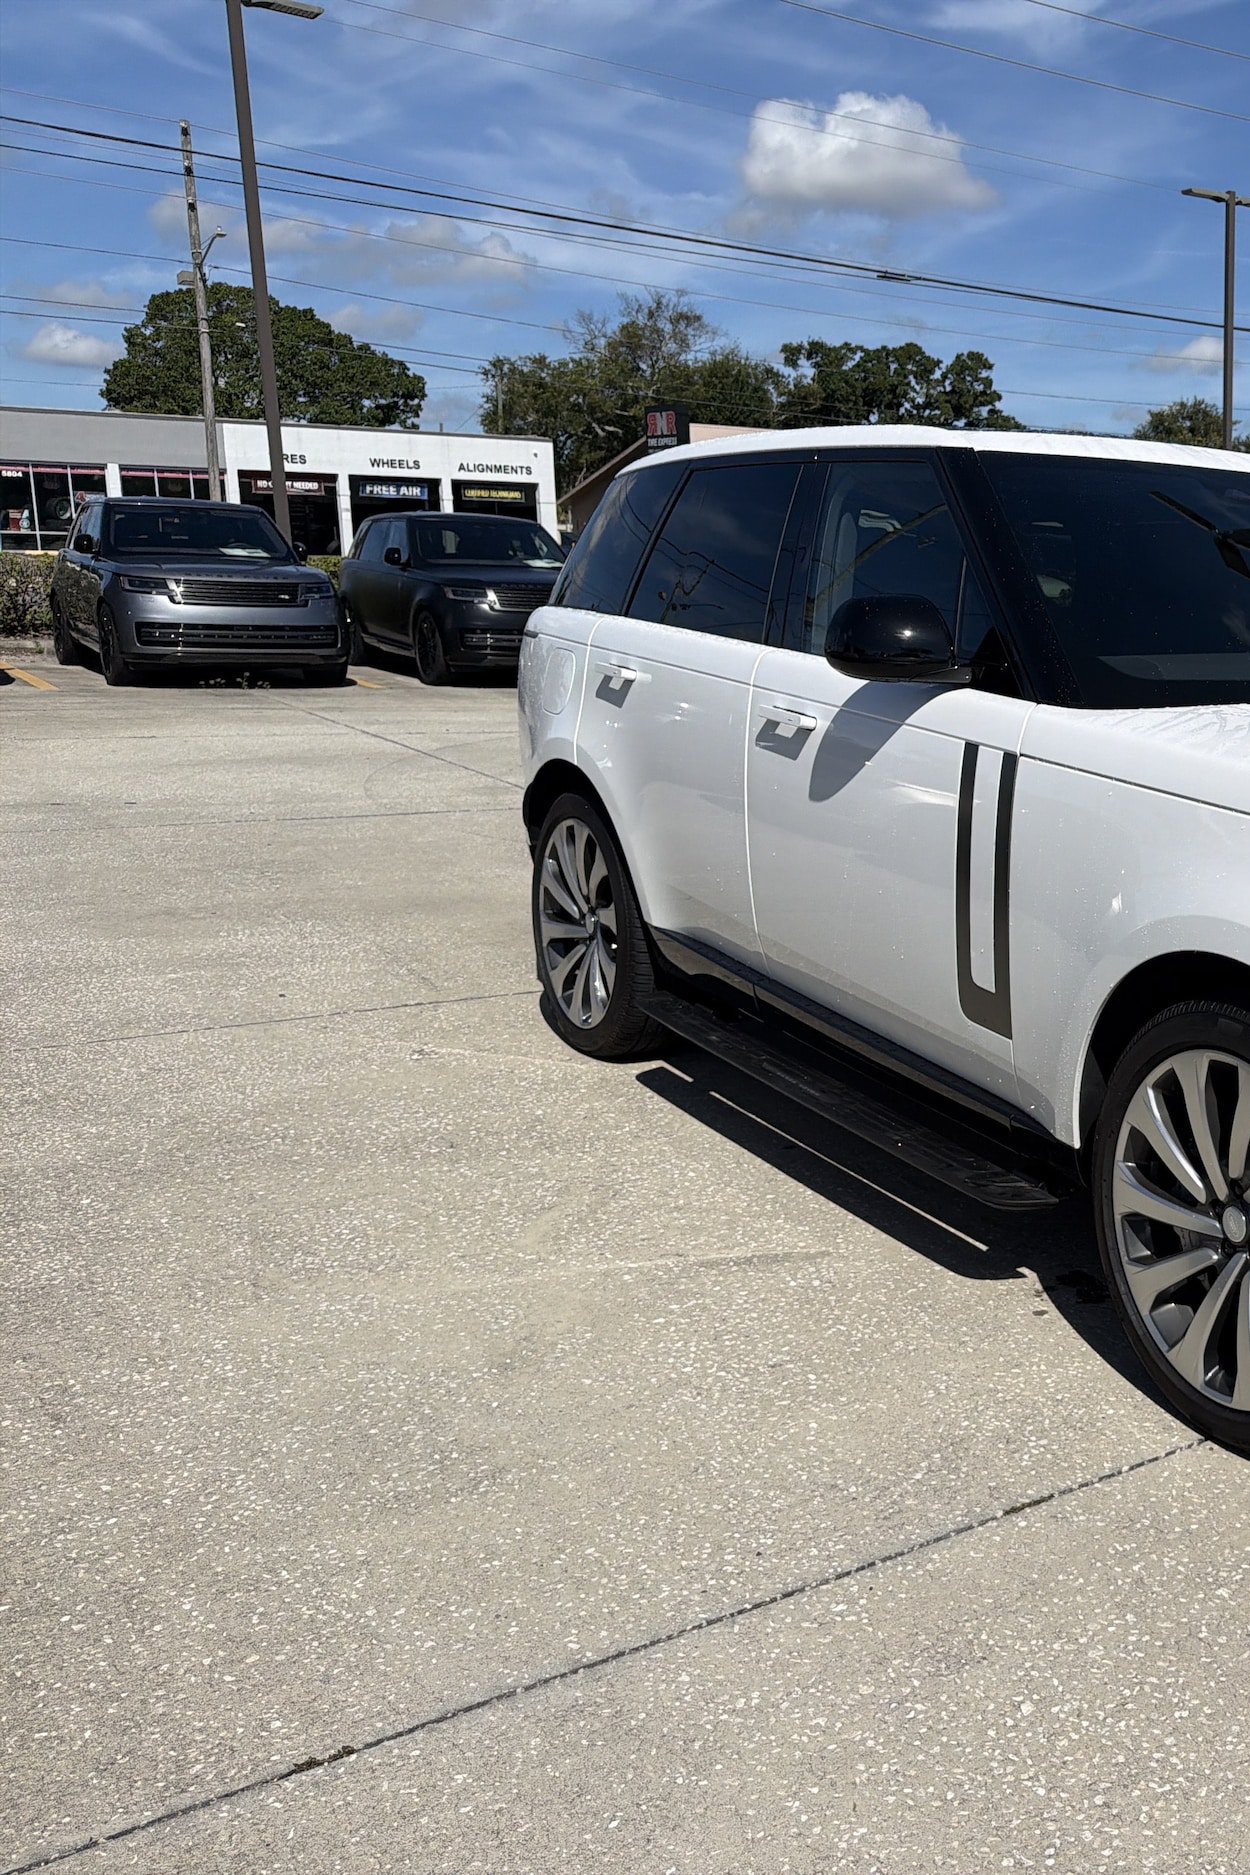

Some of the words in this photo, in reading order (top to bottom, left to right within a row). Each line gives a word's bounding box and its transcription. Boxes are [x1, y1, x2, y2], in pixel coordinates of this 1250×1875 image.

[282, 454, 307, 464] RES
[369, 457, 421, 470] WHEELS
[1, 470, 23, 478] 5804
[458, 463, 532, 475] ALIGNMENTS
[257, 480, 268, 488] NO
[293, 481, 319, 490] NEEDED
[366, 484, 397, 495] FREE
[400, 485, 421, 496] AIR
